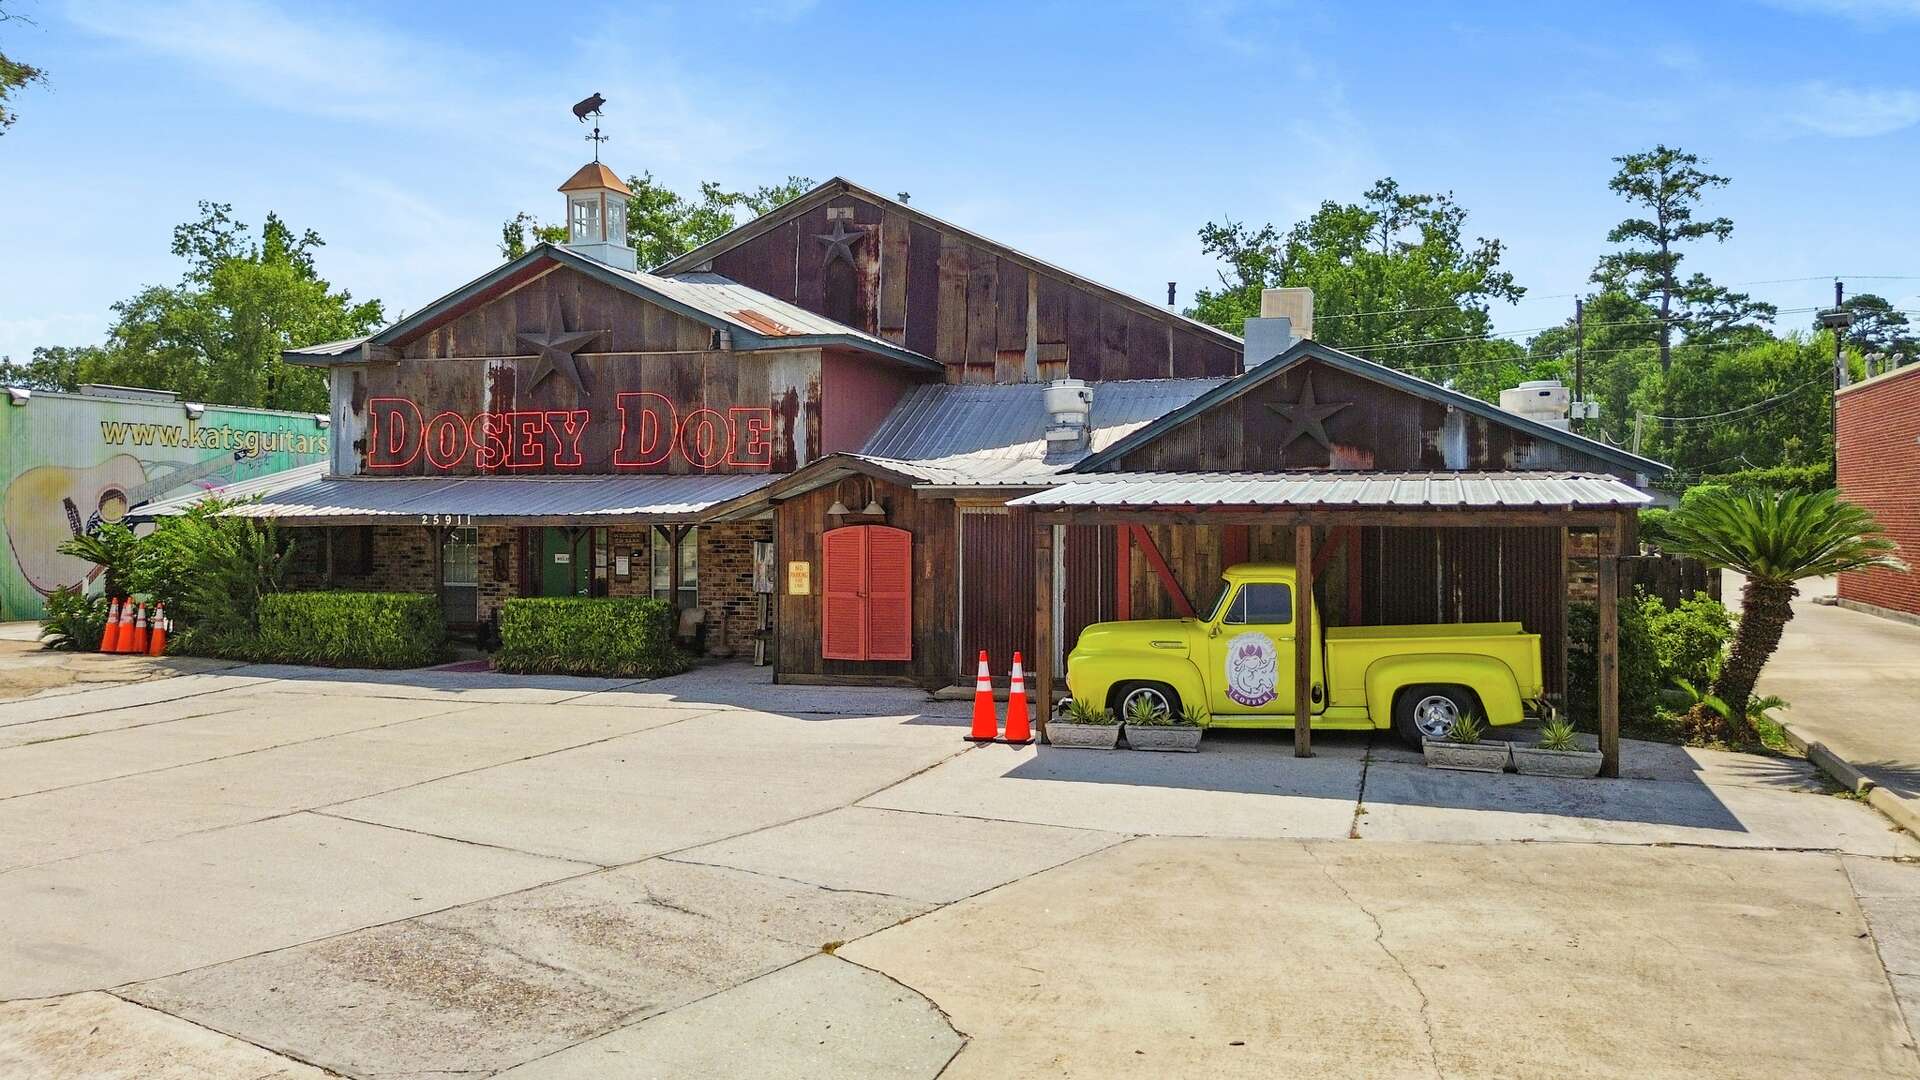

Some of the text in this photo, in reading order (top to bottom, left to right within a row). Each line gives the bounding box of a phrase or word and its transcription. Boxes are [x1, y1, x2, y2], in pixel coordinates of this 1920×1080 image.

[101, 419, 329, 458] www.katsguitars
[368, 392, 772, 469] DOSEY DOE
[421, 514, 471, 526] 25911
[1233, 693, 1270, 705] COFFEE
